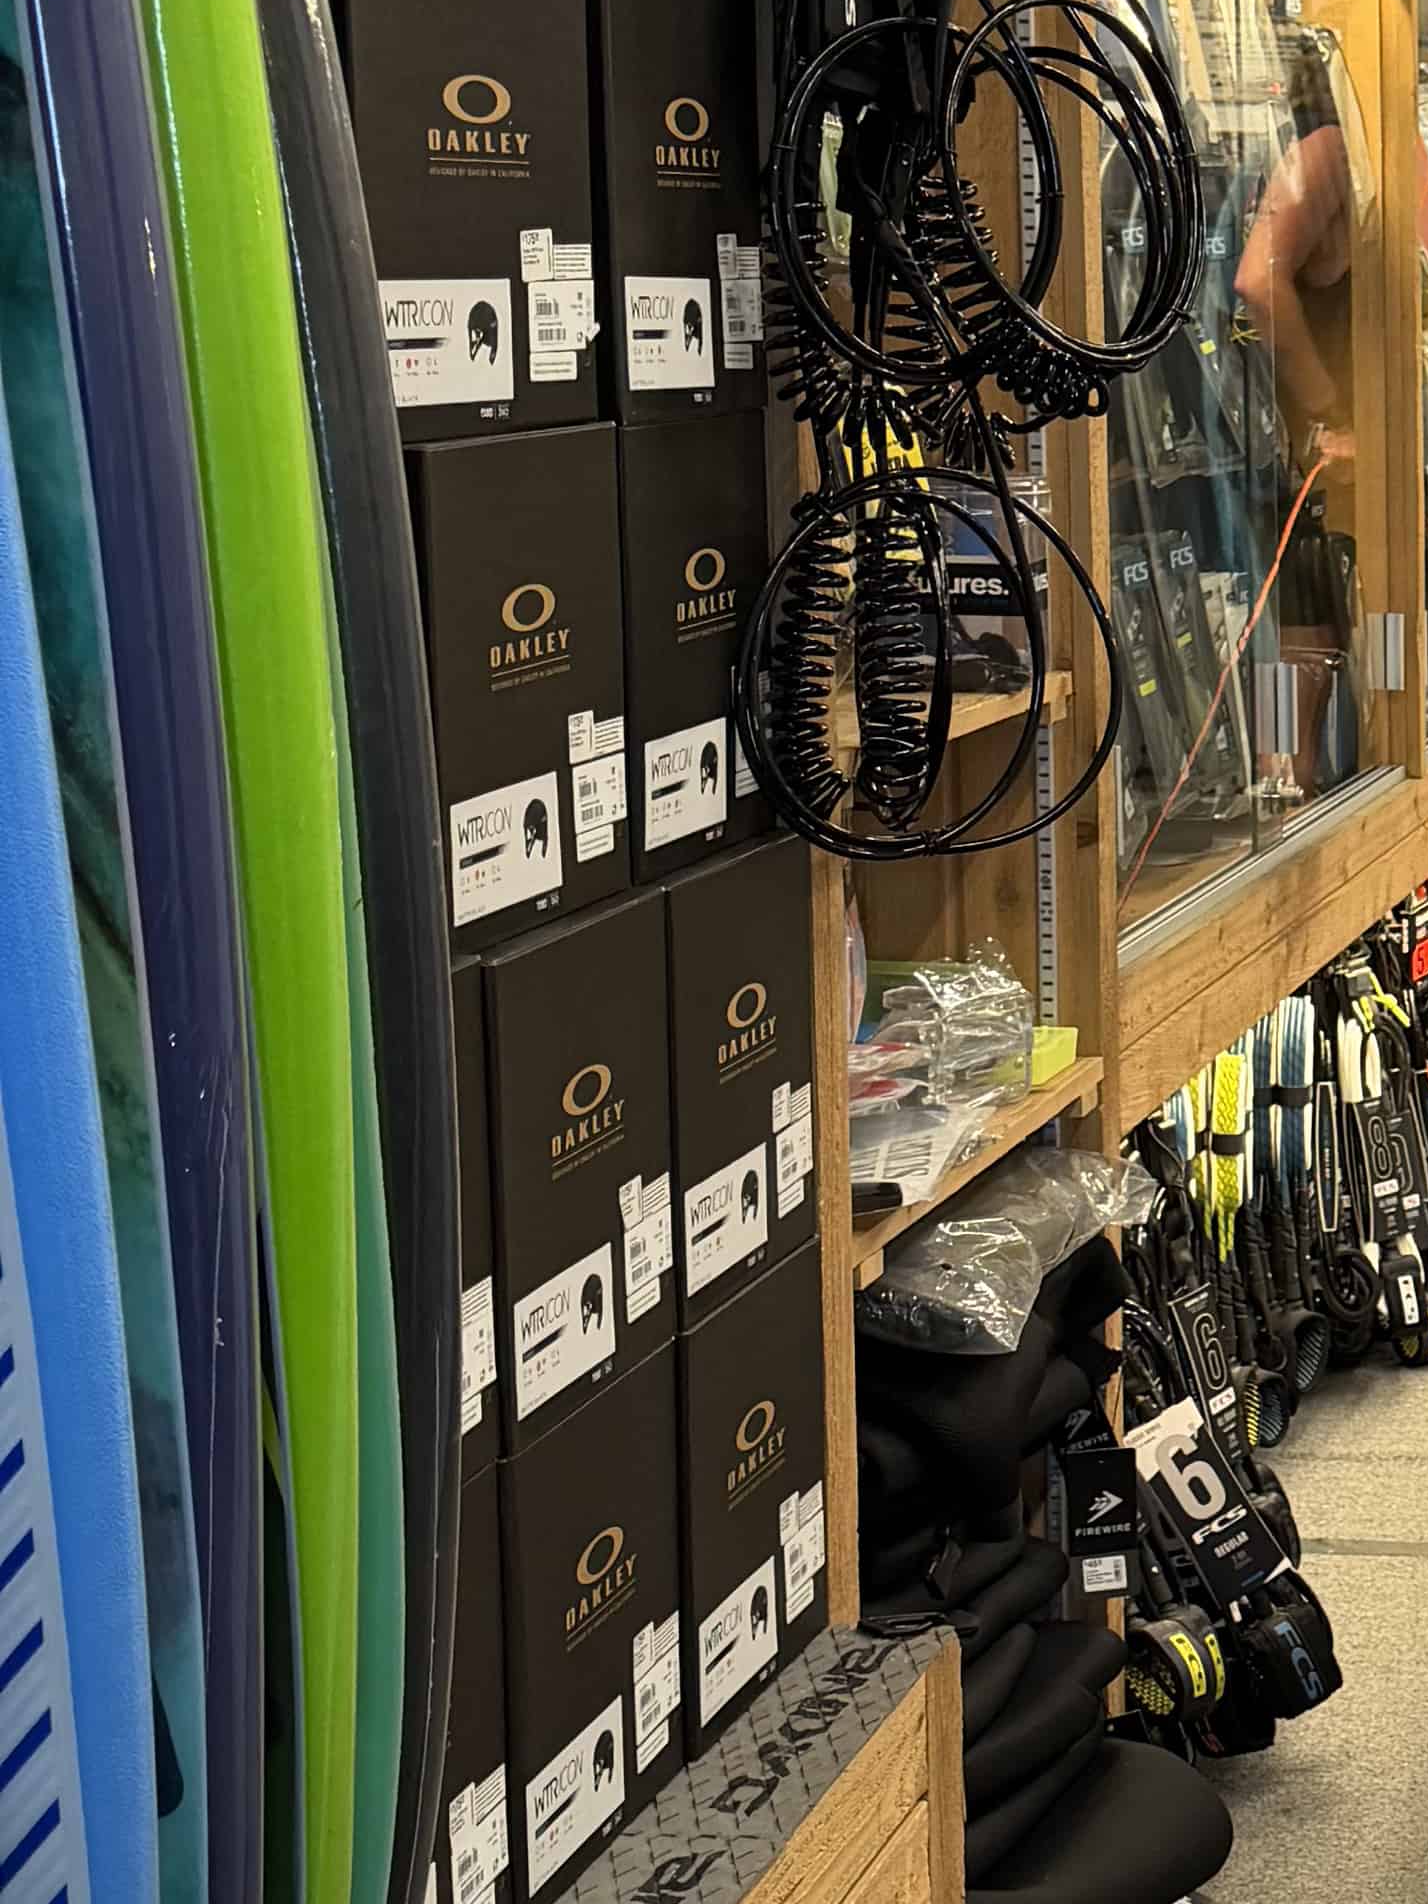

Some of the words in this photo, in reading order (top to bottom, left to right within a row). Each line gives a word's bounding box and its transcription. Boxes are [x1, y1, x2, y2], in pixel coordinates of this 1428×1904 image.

[428, 127, 531, 156] OAKLEY
[655, 144, 721, 170] OAKLEY
[1120, 224, 1145, 249] FCS
[1205, 236, 1228, 256] FCS
[1123, 560, 1149, 586] FCS
[1169, 546, 1194, 569] FCS
[676, 589, 737, 624] OAKLEY
[489, 628, 571, 669] OAKLEY
[718, 1015, 777, 1066] OAKLEY
[551, 1099, 625, 1159] OAKLEY
[1367, 1115, 1394, 1181] 8
[1192, 1313, 1228, 1391] 6
[728, 1427, 787, 1492] OAKLEY
[1155, 1433, 1227, 1521] 6
[1075, 1521, 1132, 1539] FIREWIRE
[1192, 1504, 1248, 1546] FCS
[565, 1552, 638, 1633] OAKLEY
[1274, 1620, 1325, 1700] FCS
[710, 1639, 898, 1818] DAKINE
